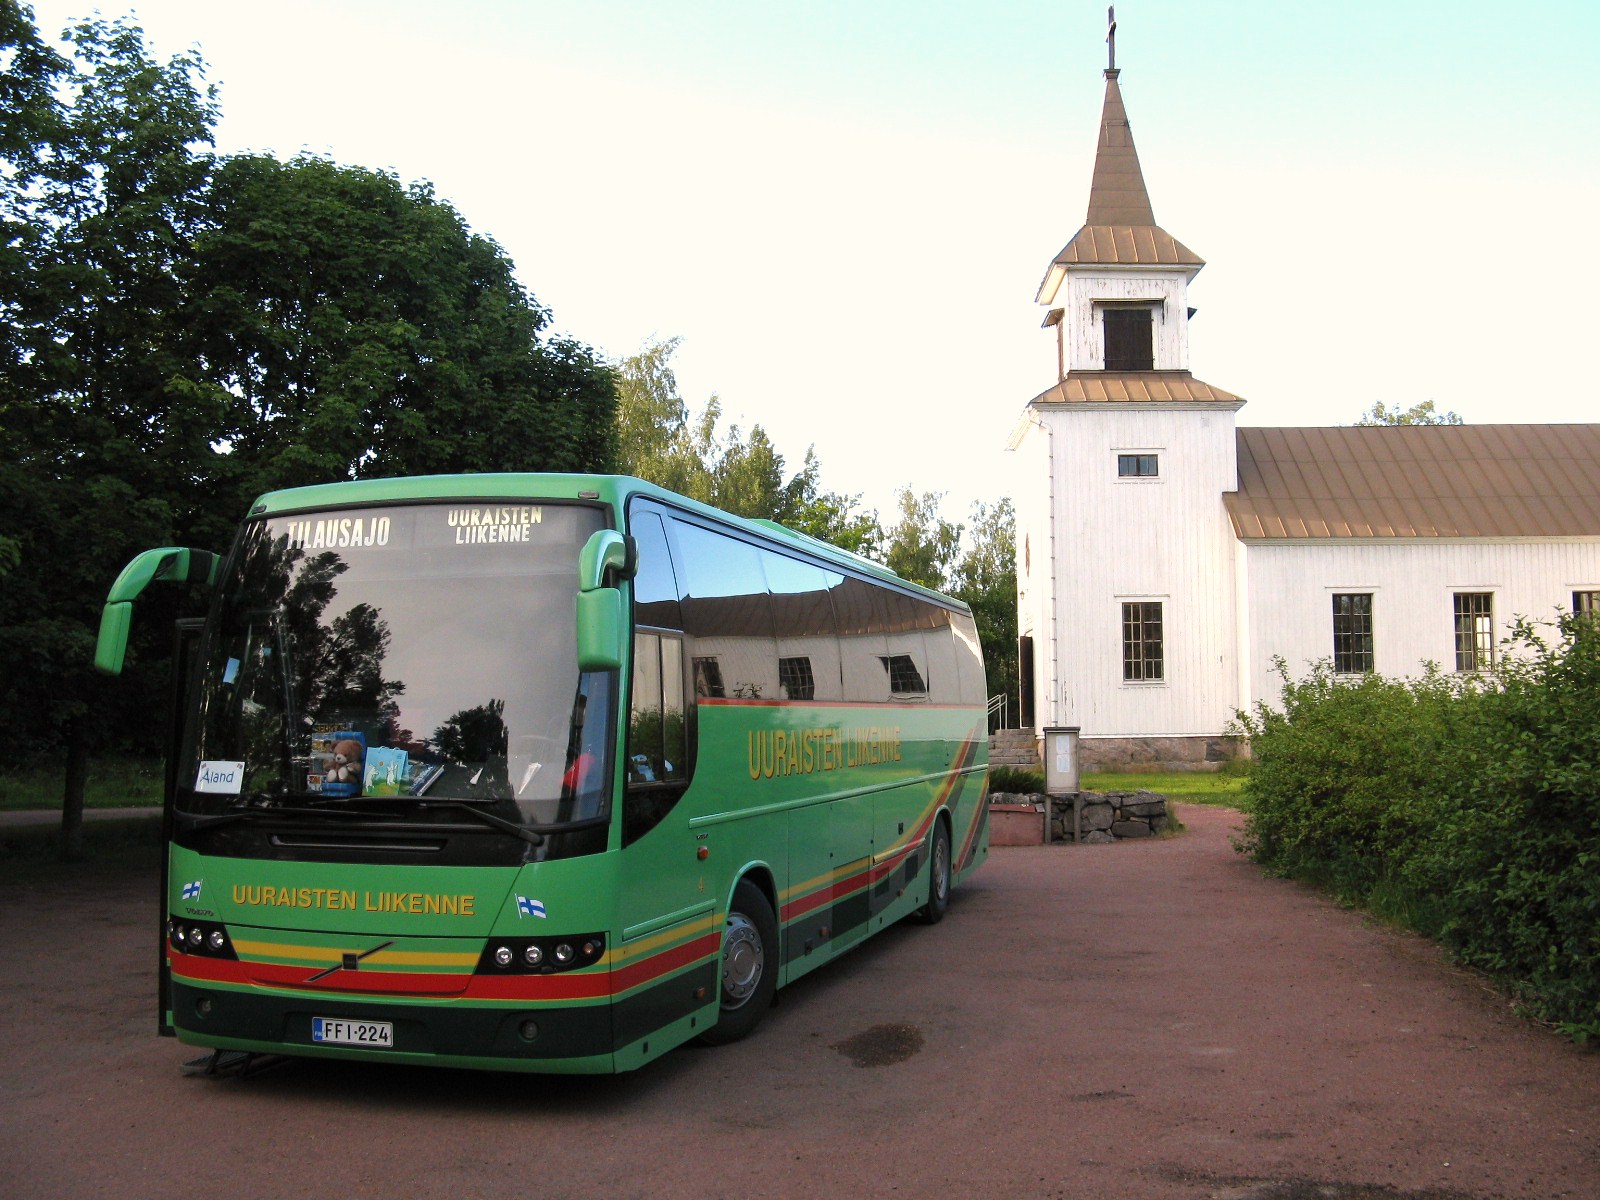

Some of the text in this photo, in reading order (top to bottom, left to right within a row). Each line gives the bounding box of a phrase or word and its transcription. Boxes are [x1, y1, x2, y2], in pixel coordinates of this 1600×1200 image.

[447, 506, 543, 527] UURAISTEN
[287, 516, 391, 549] TILAUSAJO
[455, 523, 531, 545] LIIKENNE
[749, 726, 902, 781] UURAISTEN LIIKENNE
[200, 768, 235, 784] Åland
[232, 884, 477, 916] UURAISTEN LIIKENNE
